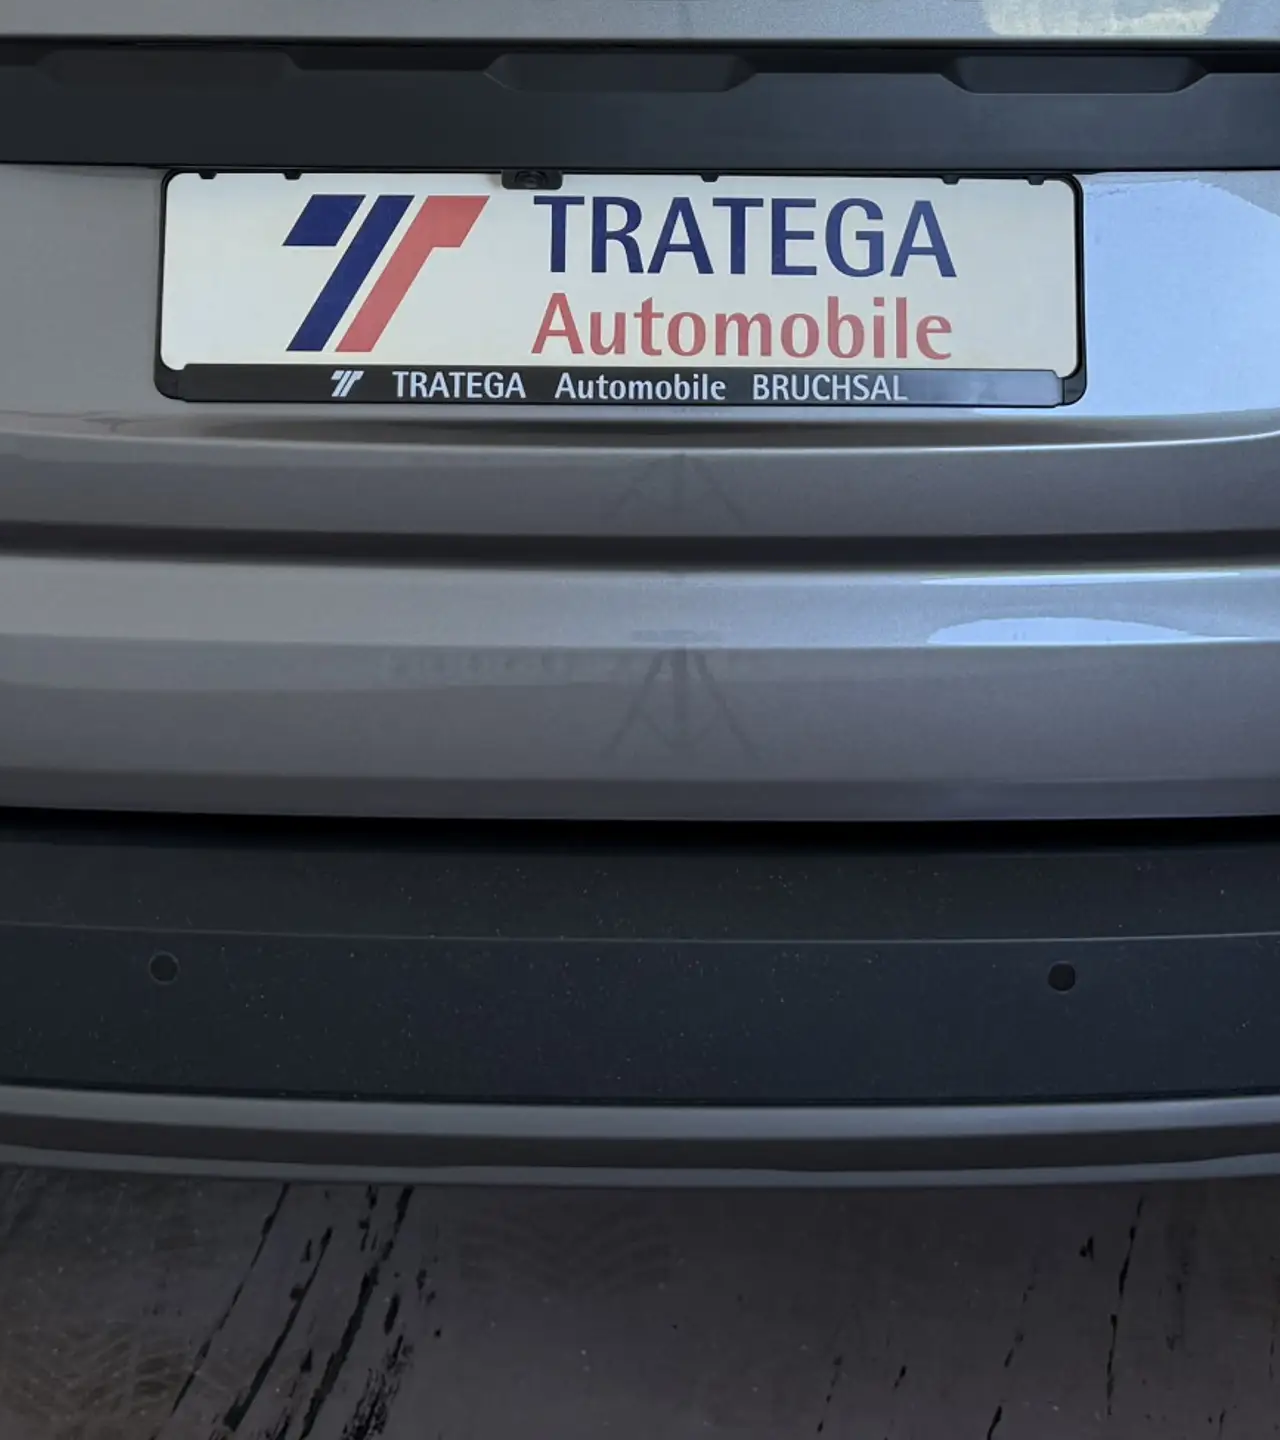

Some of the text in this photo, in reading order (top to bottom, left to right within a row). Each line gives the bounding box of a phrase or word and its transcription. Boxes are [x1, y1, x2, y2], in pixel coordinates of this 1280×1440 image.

[533, 195, 957, 279] TRATEGA
[531, 292, 953, 360] Automobile
[393, 371, 908, 402] TRATEGA Automobile BRUCHSAL
